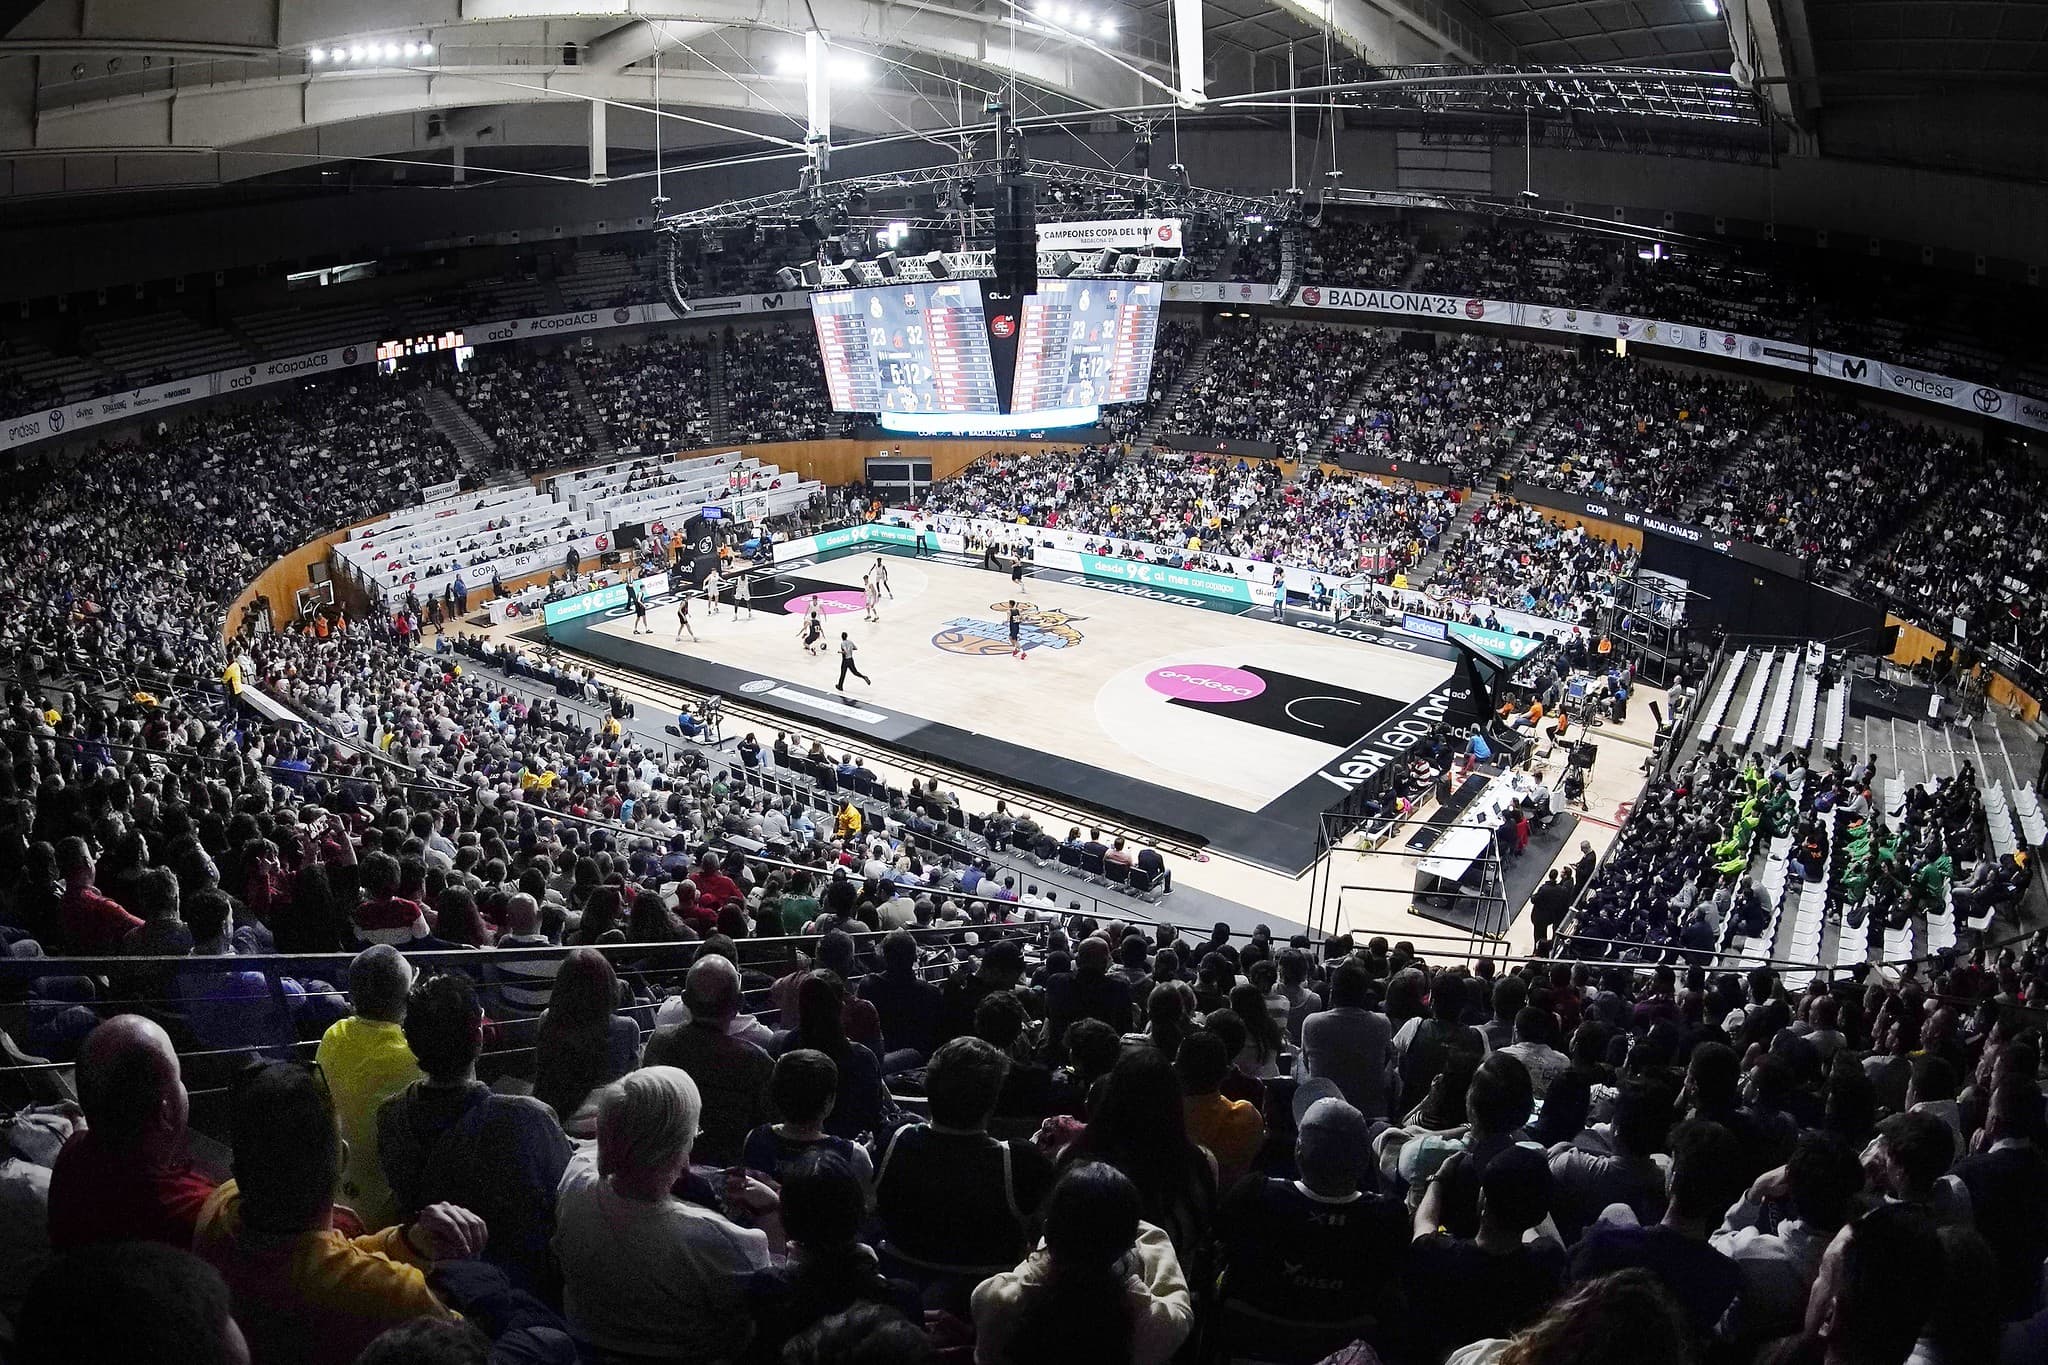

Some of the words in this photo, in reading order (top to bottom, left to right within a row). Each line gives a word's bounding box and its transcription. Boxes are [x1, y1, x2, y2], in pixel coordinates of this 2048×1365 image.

[1044, 229, 1095, 239] CAMPEONES
[1096, 228, 1118, 237] COPA
[1120, 227, 1135, 236] DEL
[1137, 227, 1153, 235] REY
[1328, 290, 1458, 315] BADALONA'23
[488, 327, 513, 341] acb
[531, 313, 598, 330] #CopaACB
[870, 328, 886, 346] 23
[906, 326, 923, 345] 32
[1072, 320, 1086, 339] 23
[1102, 320, 1115, 338] 32
[230, 372, 253, 388] acb
[267, 355, 328, 376] #CopaACB
[890, 363, 922, 385] 5:12
[1079, 357, 1104, 379] 5:12
[1098, 386, 1105, 402] 2
[1894, 372, 1954, 400] endesa
[924, 393, 933, 409] 2
[8, 421, 41, 441] endesa
[1586, 503, 1609, 517] COPA
[1624, 512, 1640, 524] REY
[515, 555, 532, 567] REY
[681, 563, 694, 574] acb
[1095, 560, 1124, 575] desde
[1126, 562, 1151, 582] 9€
[1154, 571, 1165, 582] al
[1168, 575, 1189, 586] mes
[1064, 576, 1206, 607] Badalona
[1296, 620, 1419, 651] endesa
[1467, 632, 1506, 650] desde
[1159, 670, 1254, 697] endesa
[1451, 689, 1467, 701] acb
[1317, 748, 1396, 793] Rey
